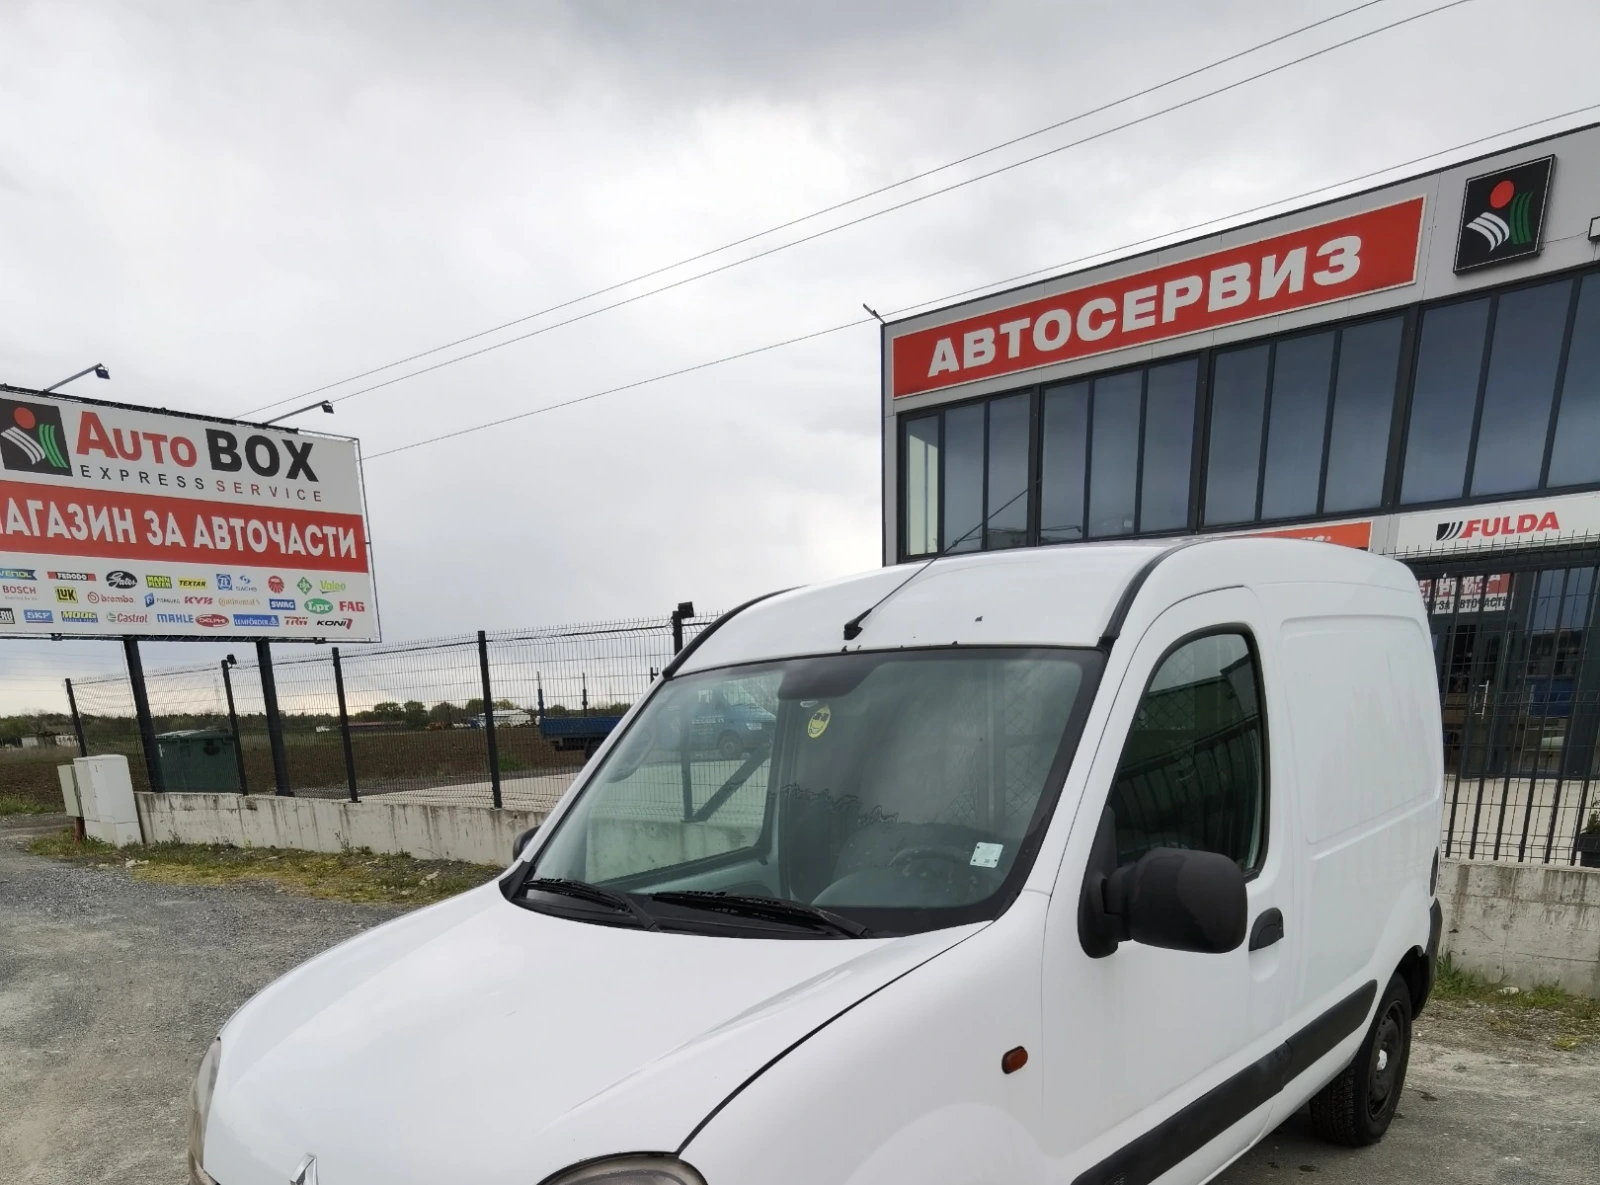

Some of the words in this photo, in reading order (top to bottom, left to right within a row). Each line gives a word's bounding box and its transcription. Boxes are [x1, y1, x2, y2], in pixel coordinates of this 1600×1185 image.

[927, 233, 1363, 379] АВТОСЕРВИЗ
[205, 428, 319, 483] BOX
[80, 464, 204, 490] EXPRESS
[216, 480, 322, 502] SERVICE
[0, 497, 137, 545] АГАЗИН
[146, 510, 187, 549] ЗА
[193, 514, 357, 560] АВТОЧАСТИ
[1458, 511, 1560, 539] FULDA
[3, 585, 36, 594] BOSCH
[101, 594, 134, 603] brembo
[339, 601, 365, 612] FAG
[27, 611, 50, 619] SKF
[117, 613, 148, 623] Castrol
[157, 613, 194, 623] MAHLE
